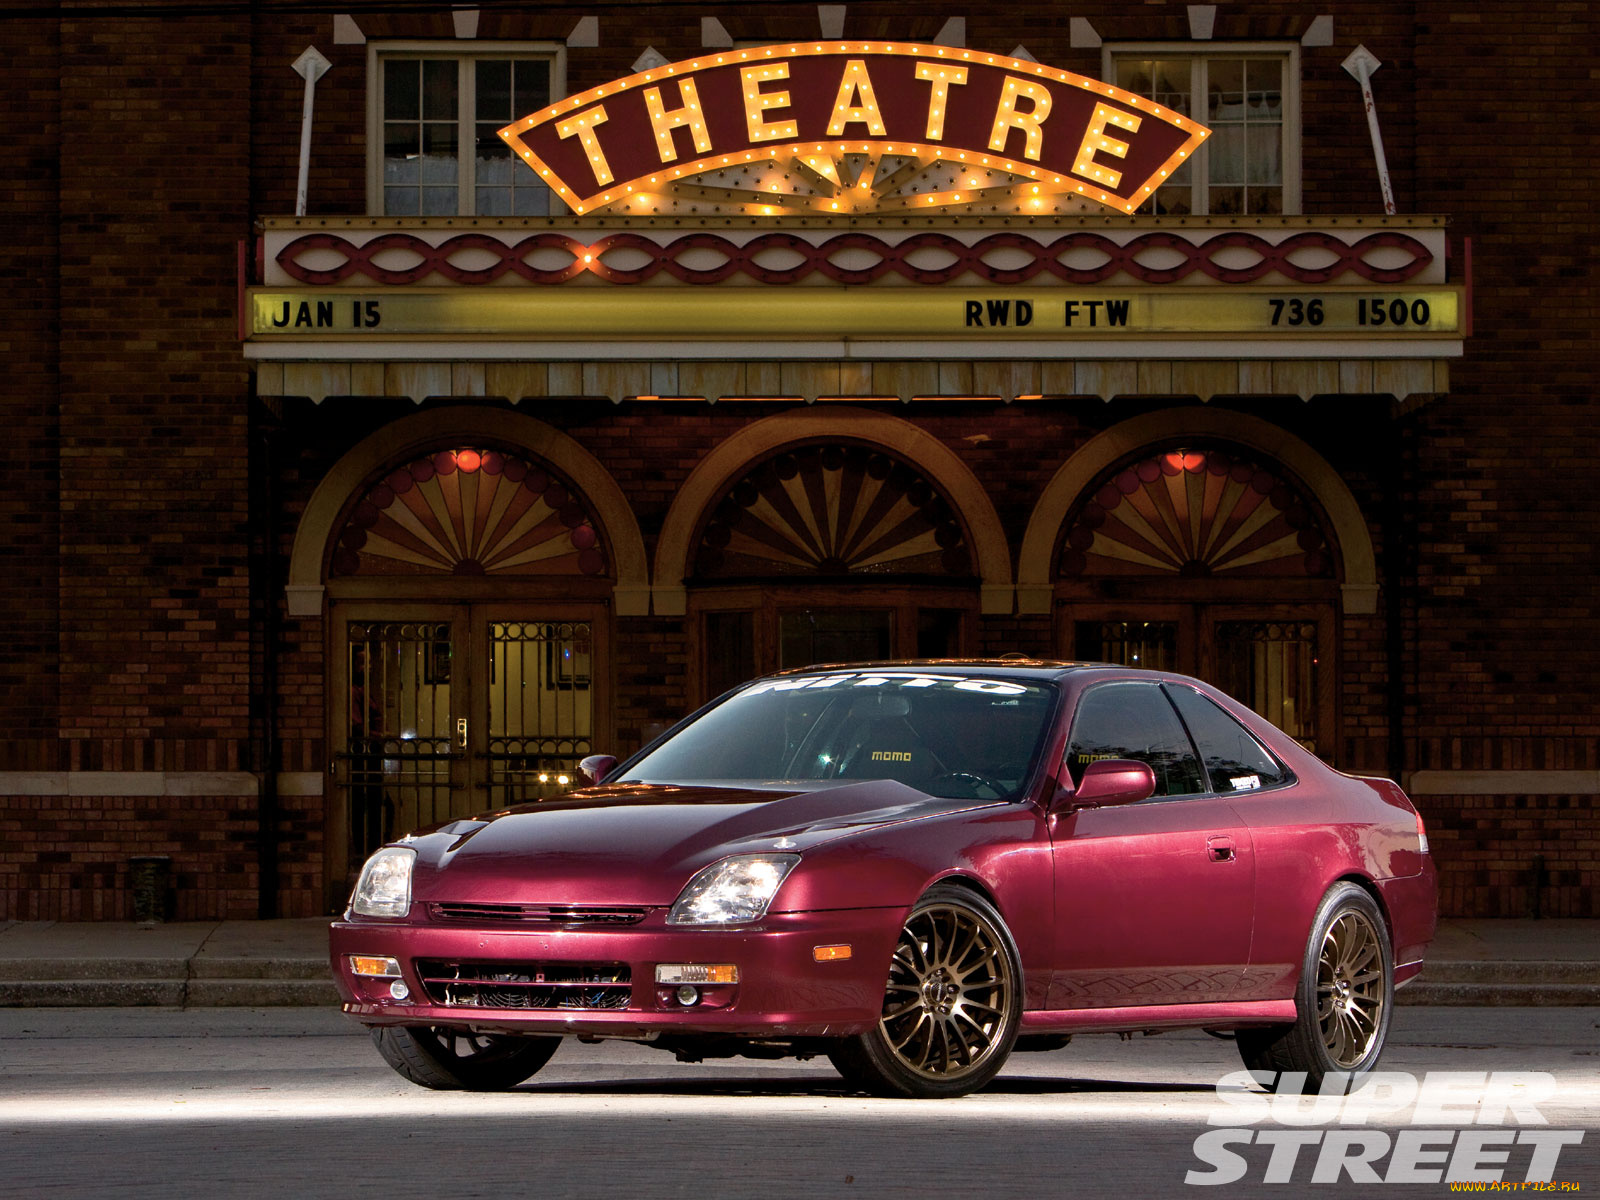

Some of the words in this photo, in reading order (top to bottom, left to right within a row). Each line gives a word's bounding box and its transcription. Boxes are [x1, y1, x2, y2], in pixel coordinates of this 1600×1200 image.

[555, 60, 1142, 190] THEATRE
[273, 301, 333, 328] JAN
[353, 301, 381, 328] 15
[966, 300, 1033, 327] RWD
[1065, 300, 1129, 327] FTW
[1269, 299, 1325, 326] 736
[1358, 299, 1430, 326] 1500
